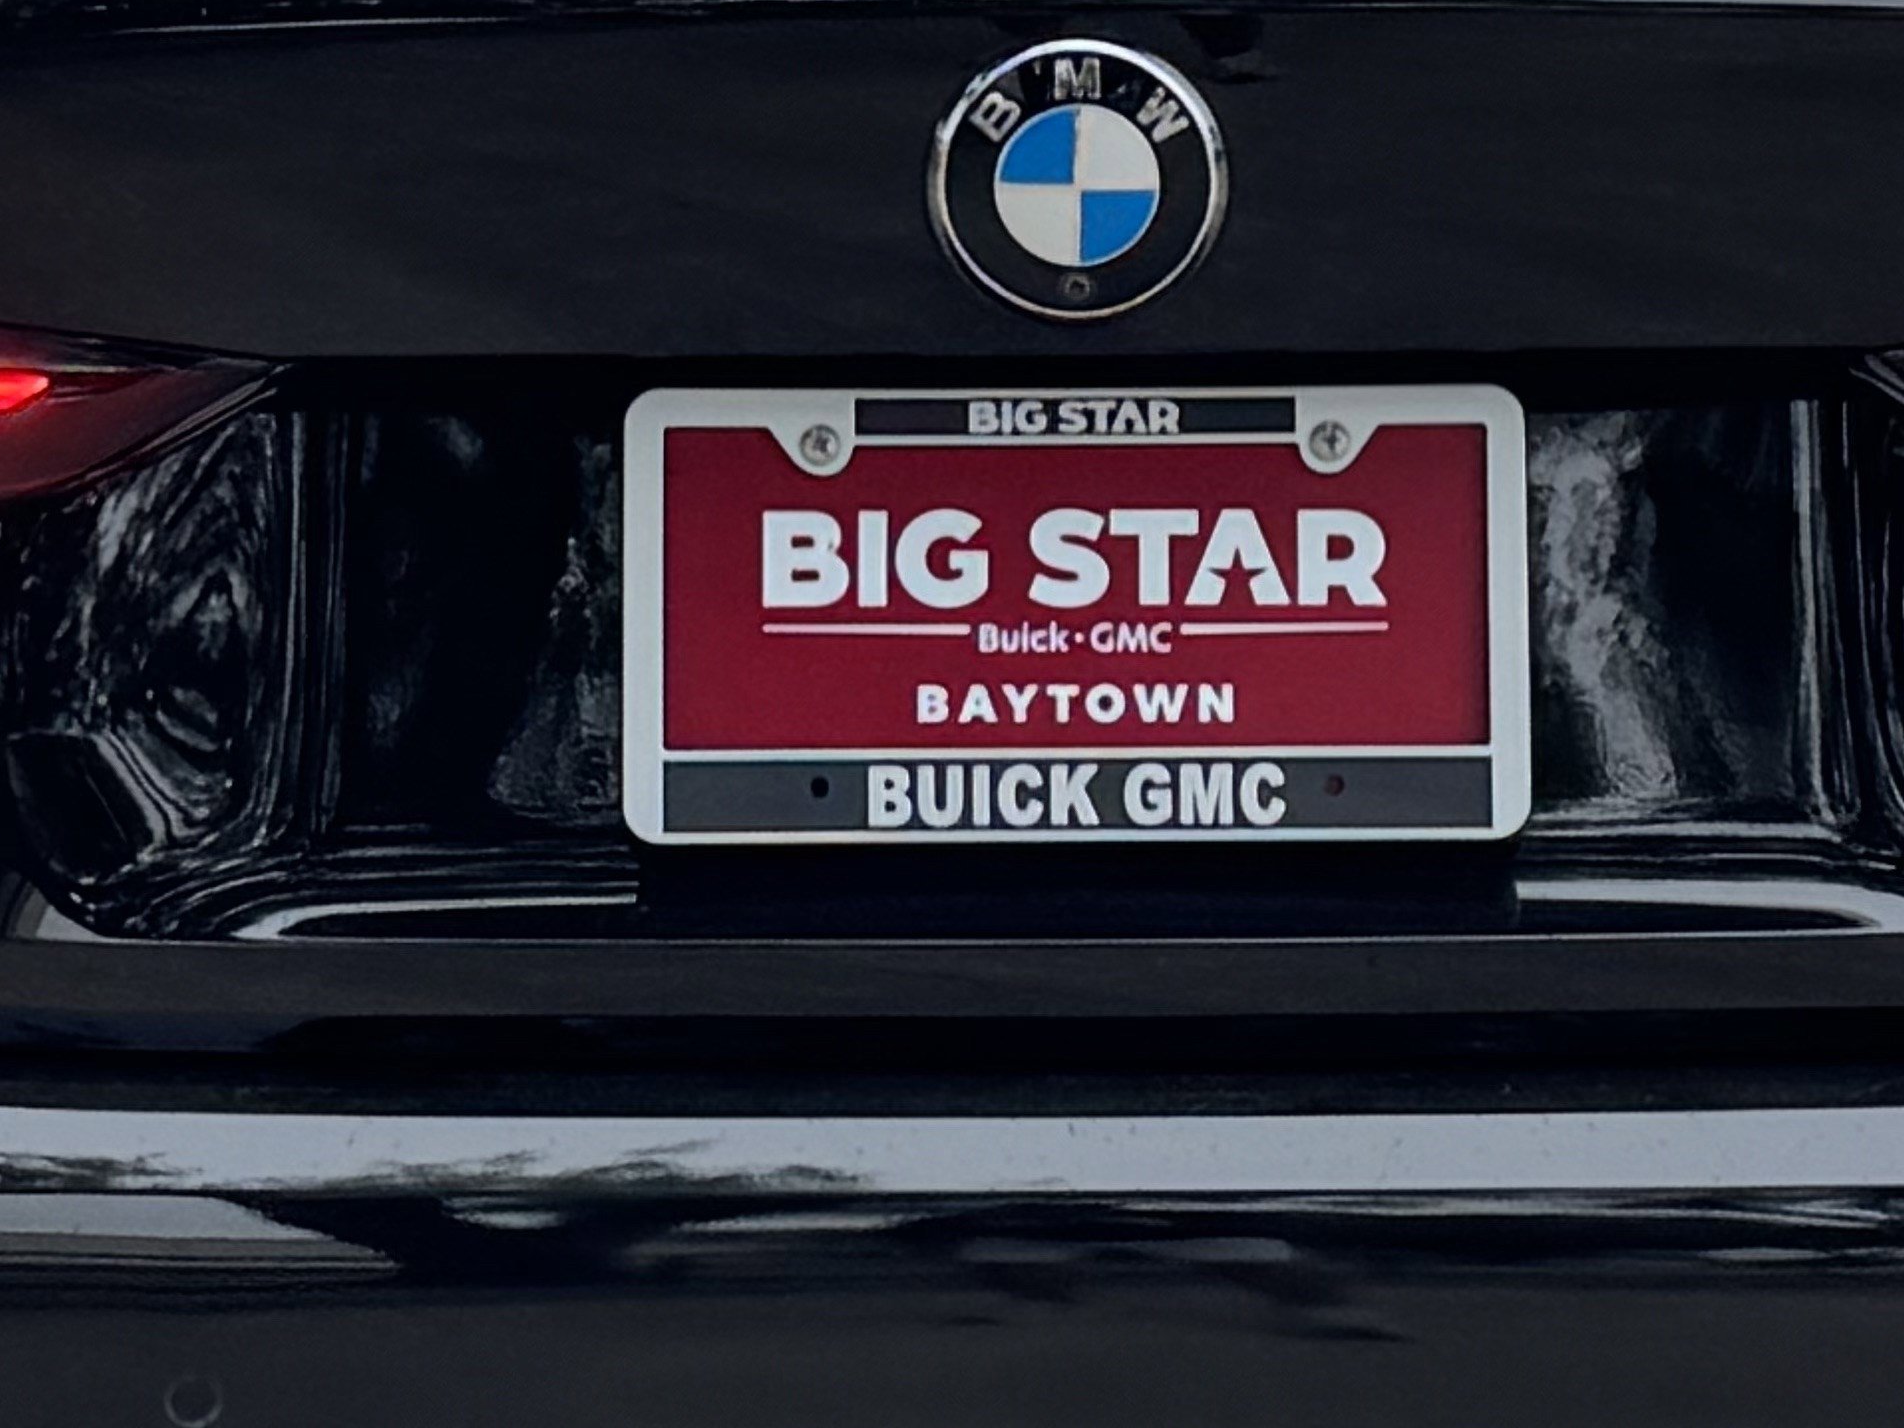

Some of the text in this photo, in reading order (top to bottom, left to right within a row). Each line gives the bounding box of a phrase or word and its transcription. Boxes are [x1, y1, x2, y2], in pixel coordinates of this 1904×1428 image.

[969, 57, 1189, 143] BMW
[968, 399, 1180, 436] BIG STAR
[762, 508, 1388, 610] BIG STAR
[916, 683, 1235, 724] BAYTOWN
[867, 762, 1287, 828] BUICK GMC
